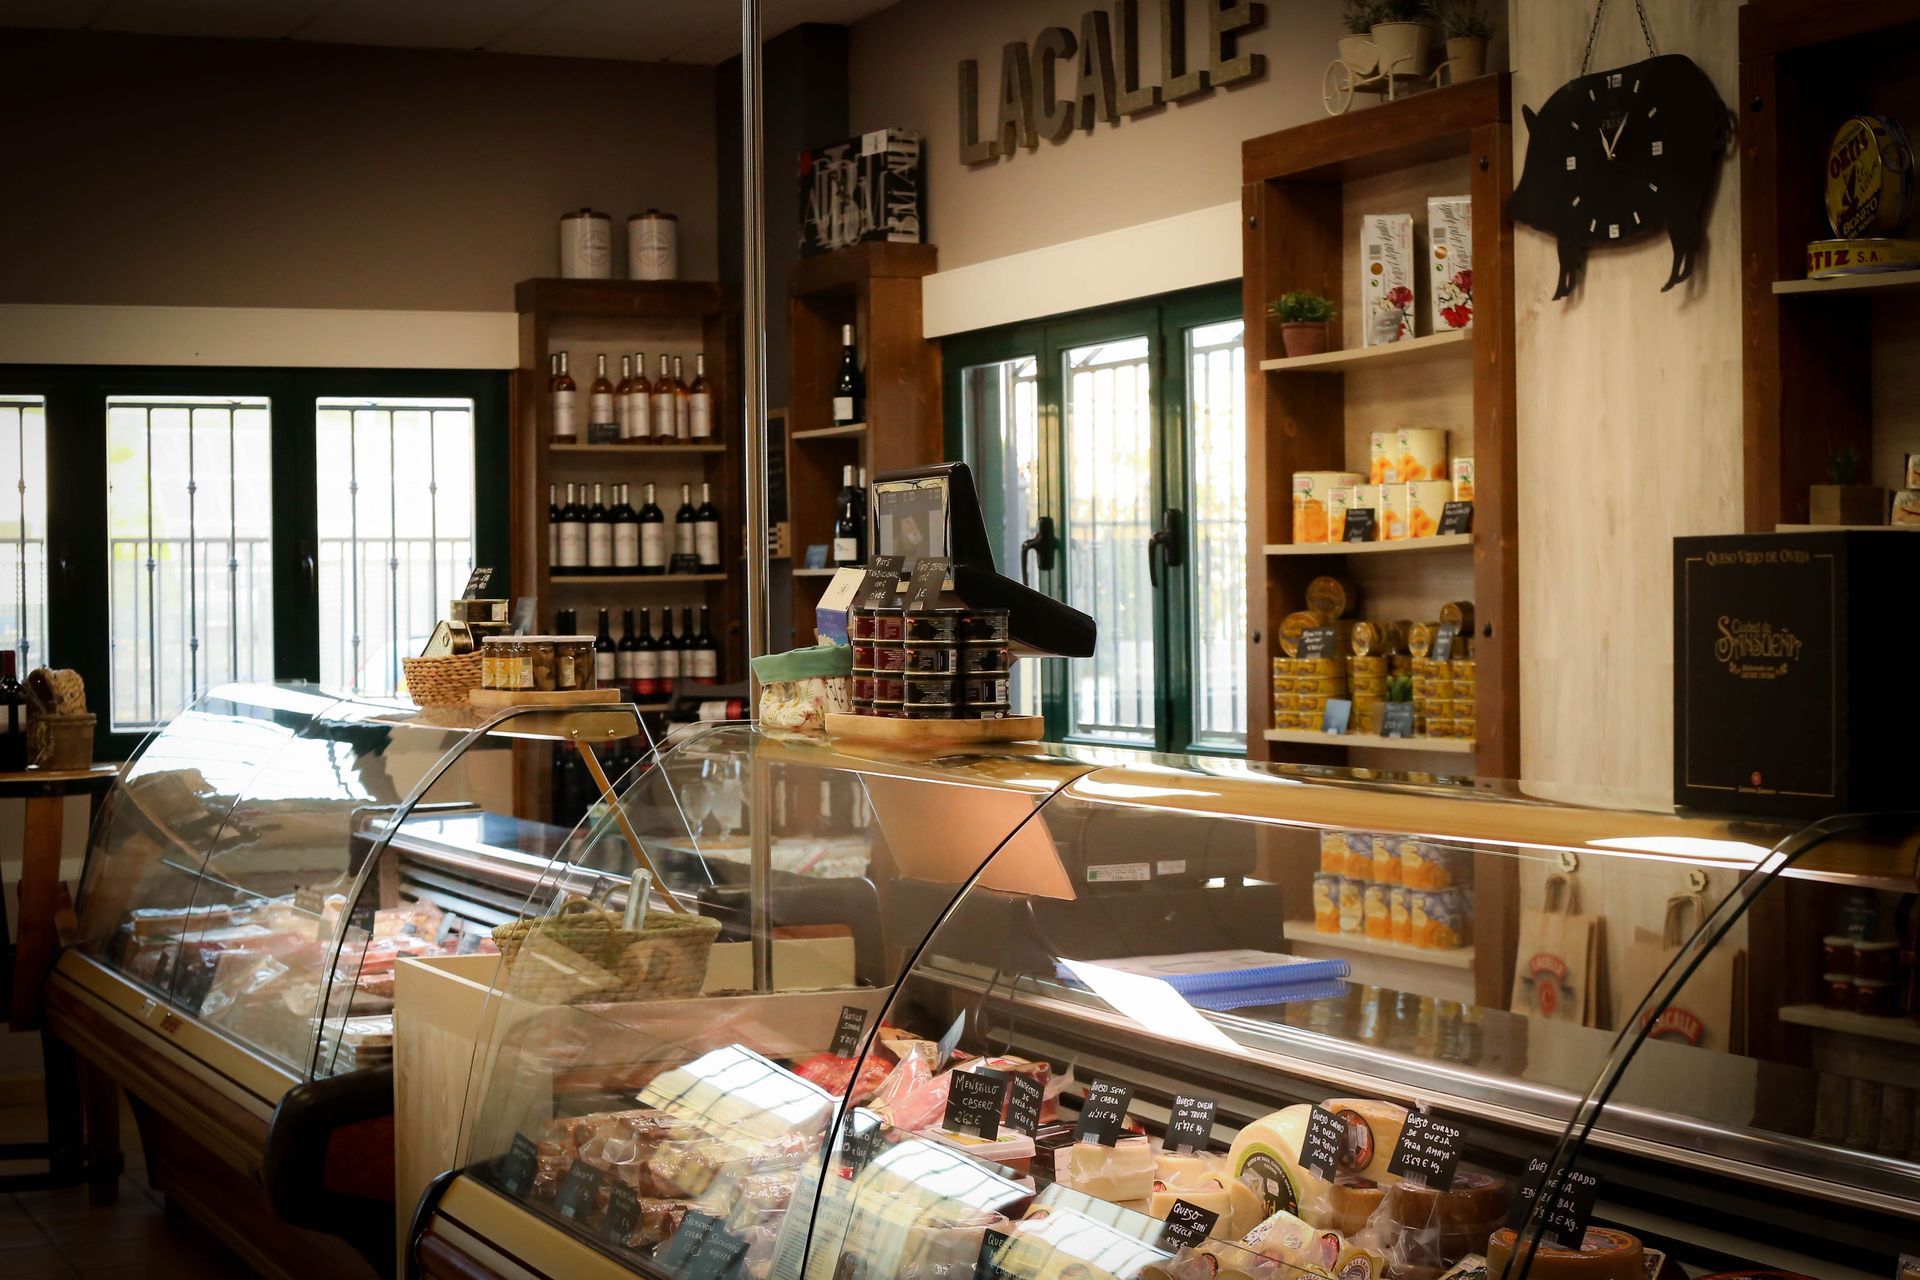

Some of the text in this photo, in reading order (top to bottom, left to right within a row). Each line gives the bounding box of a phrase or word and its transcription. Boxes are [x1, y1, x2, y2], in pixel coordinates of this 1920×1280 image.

[959, 0, 1266, 166] LACALLE
[962, 1097, 994, 1110] CASERO
[1406, 1128, 1417, 1137] DE
[1407, 1113, 1460, 1138] QUESO CURADO
[1173, 1202, 1203, 1221] QUESO
